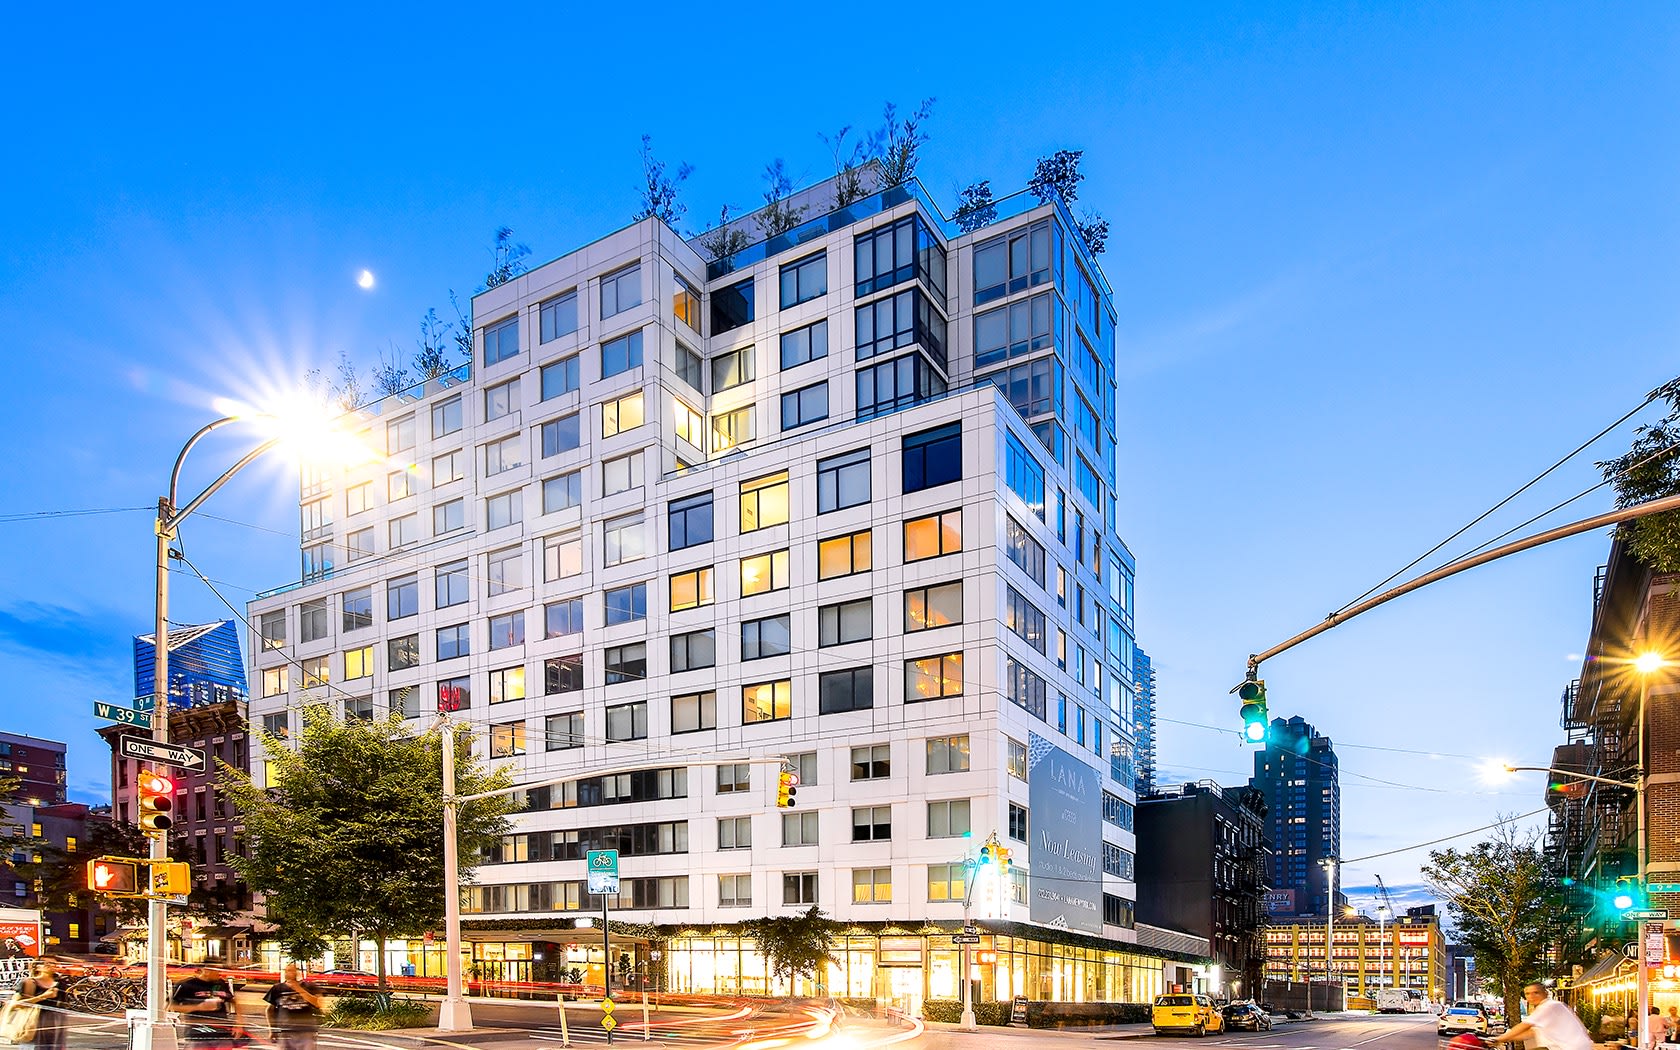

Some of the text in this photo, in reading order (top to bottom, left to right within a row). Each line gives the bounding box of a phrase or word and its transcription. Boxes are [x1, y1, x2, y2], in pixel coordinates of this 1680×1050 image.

[97, 703, 149, 723] W 39 ST
[138, 699, 144, 710] 9
[129, 743, 155, 755] ONE
[168, 750, 194, 762] WAY
[1050, 759, 1086, 796] LANA
[1040, 829, 1097, 875] Now Leasing
